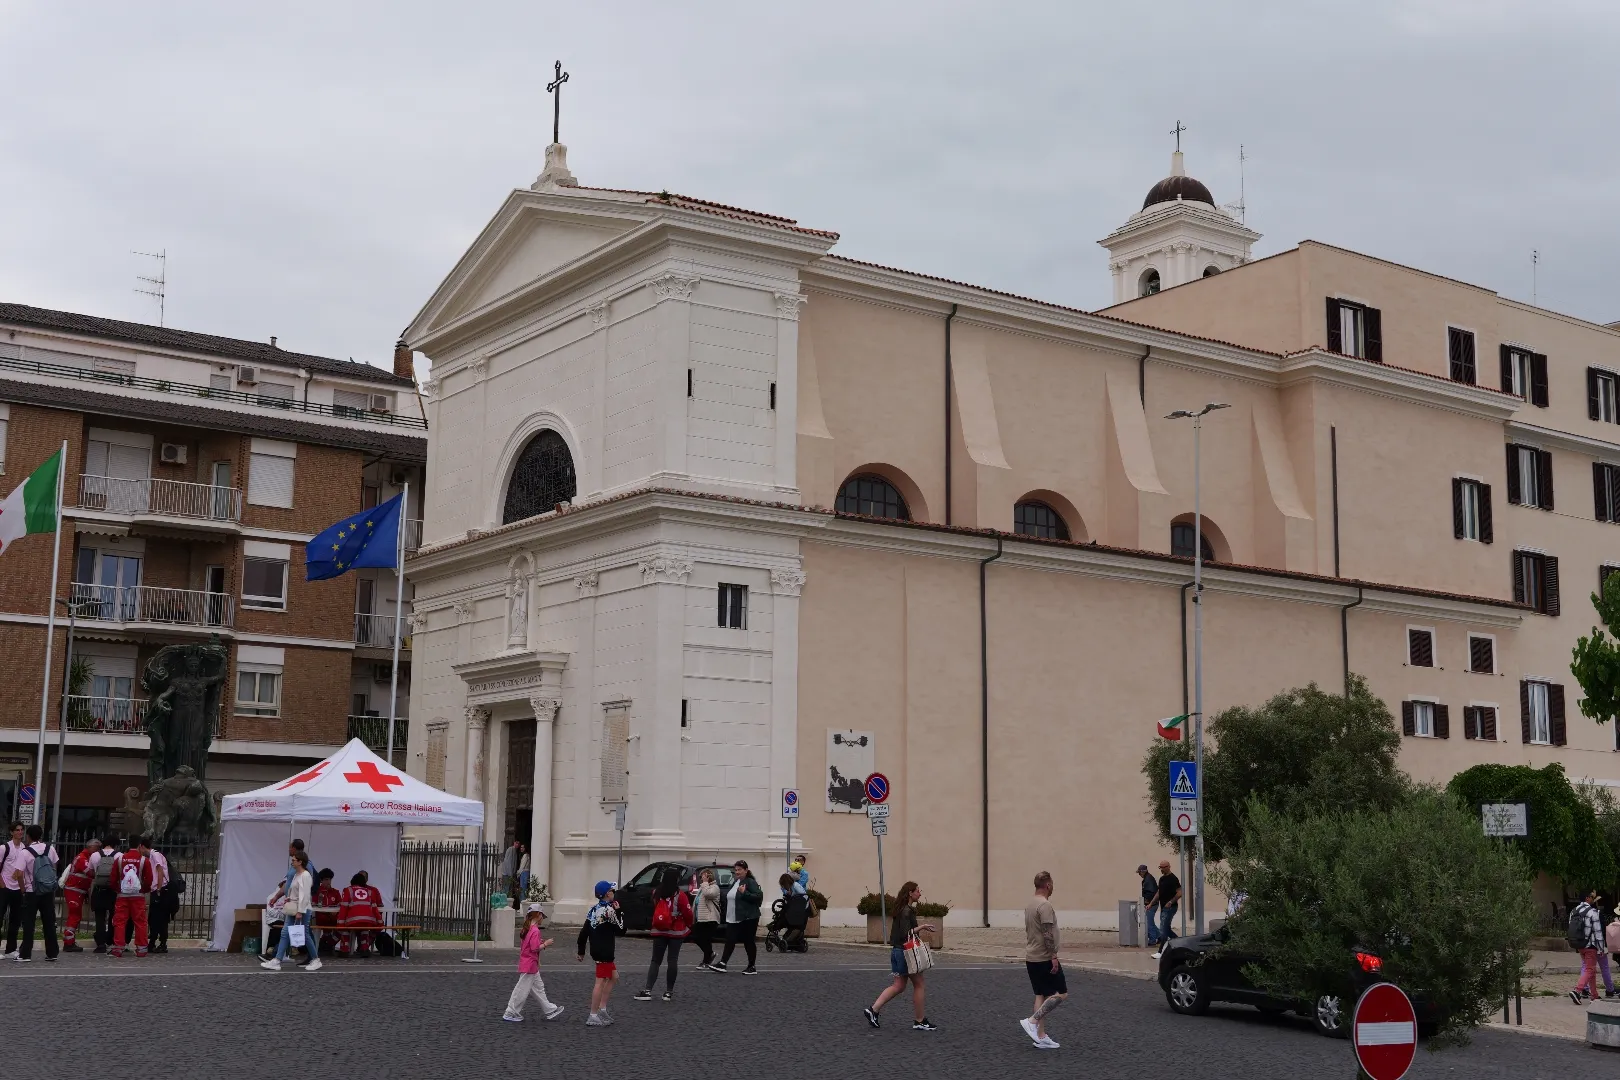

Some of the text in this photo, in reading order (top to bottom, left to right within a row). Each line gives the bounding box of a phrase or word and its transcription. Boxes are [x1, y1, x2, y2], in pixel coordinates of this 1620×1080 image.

[360, 801, 443, 813] Croce Rossa Italiana
